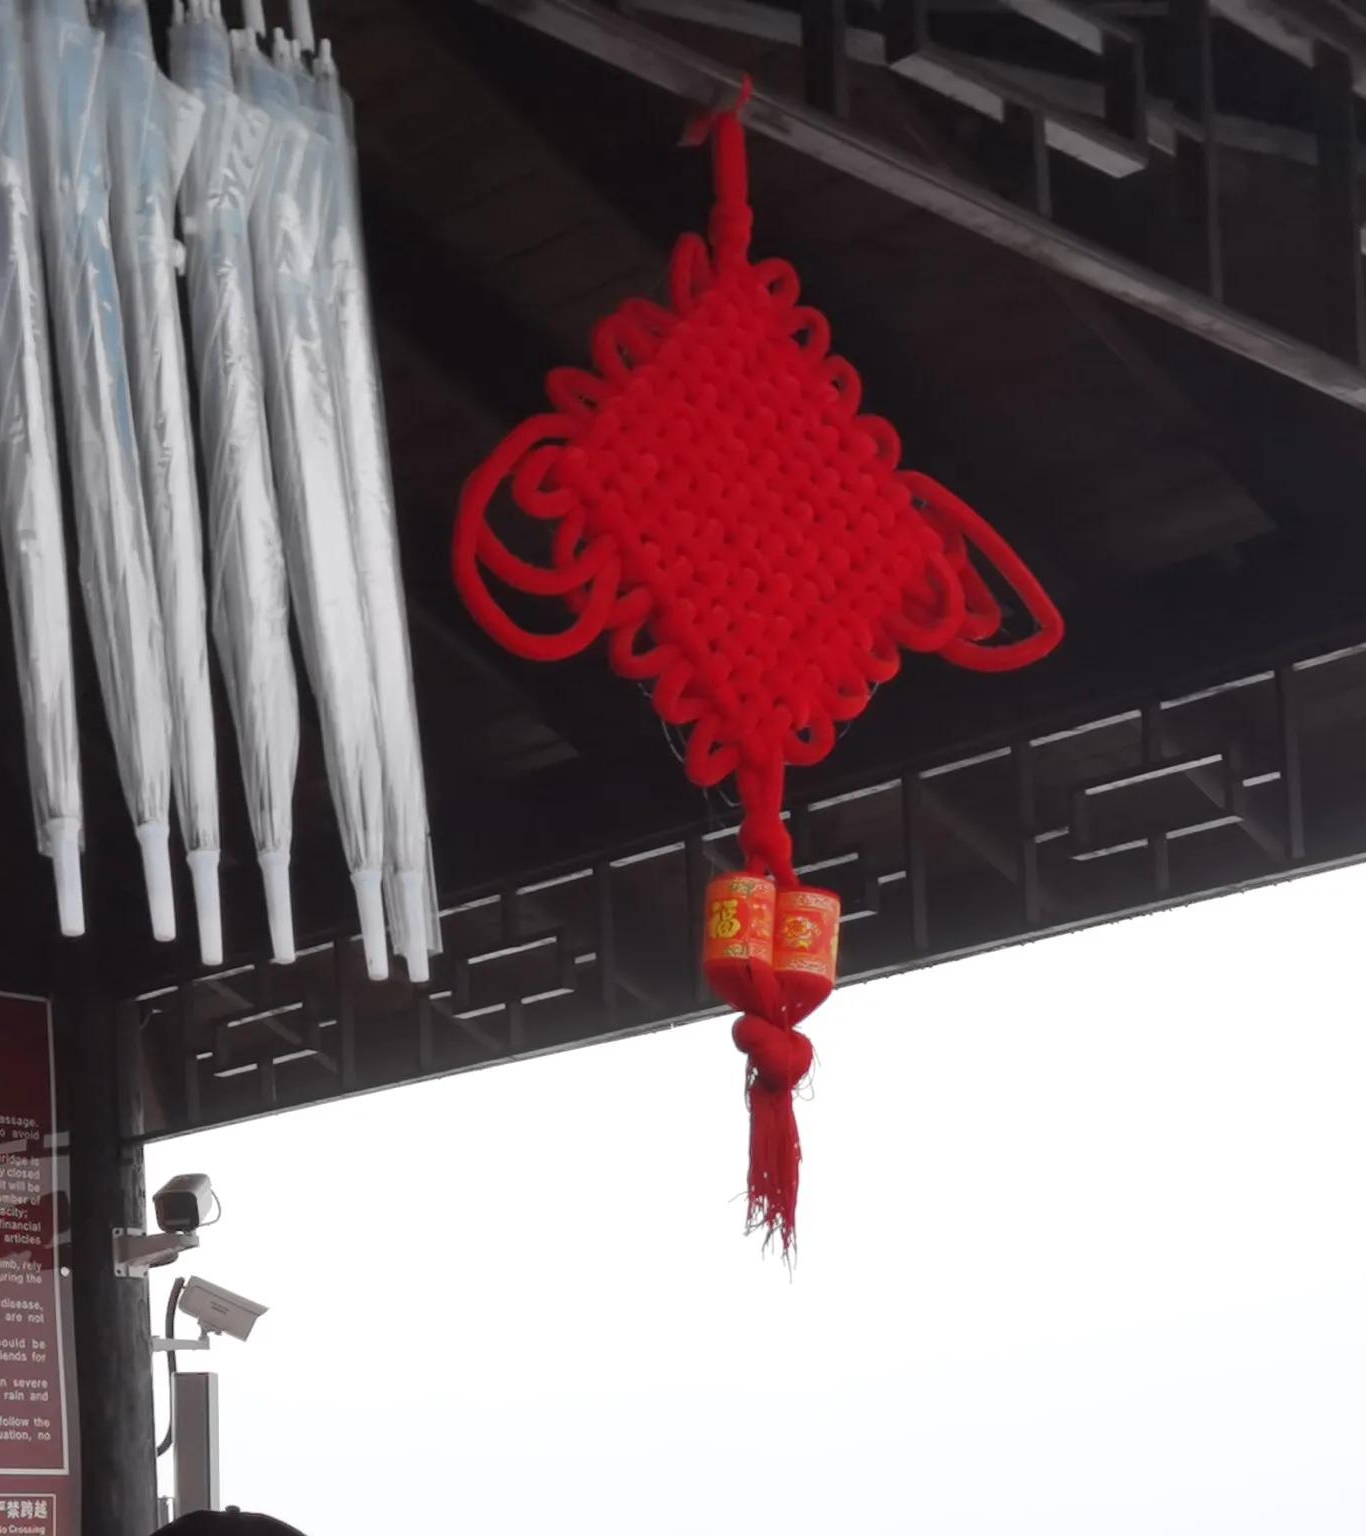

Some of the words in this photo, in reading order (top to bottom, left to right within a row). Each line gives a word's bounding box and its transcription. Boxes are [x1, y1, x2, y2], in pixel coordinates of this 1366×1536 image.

[708, 899, 741, 939] 福
[25, 1272, 42, 1283] the
[4, 1312, 22, 1321] are
[27, 1312, 44, 1322] not
[31, 1338, 46, 1348] be
[31, 1351, 46, 1362] for
[12, 1379, 47, 1388] severe
[3, 1390, 24, 1400] rain
[29, 1391, 48, 1401] and
[33, 1417, 49, 1427] the
[37, 1432, 50, 1440] no
